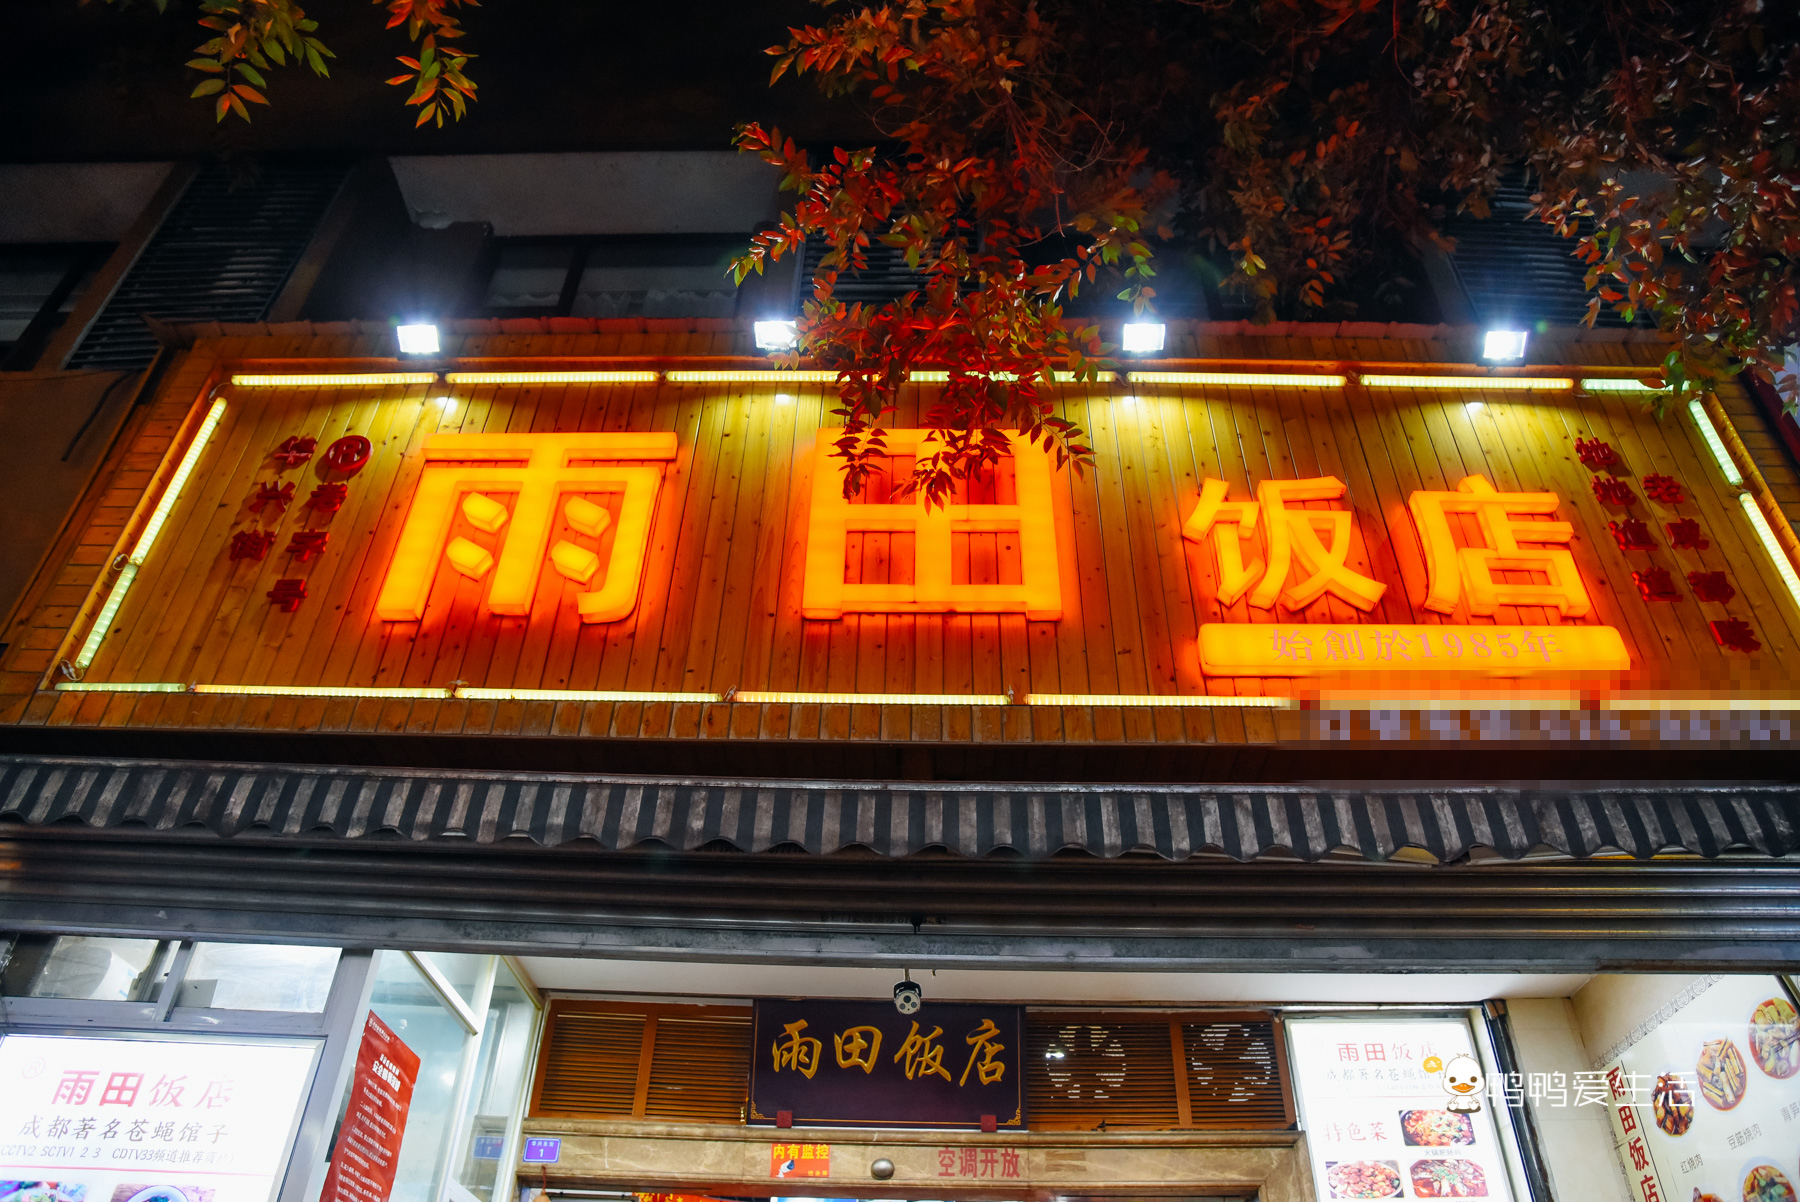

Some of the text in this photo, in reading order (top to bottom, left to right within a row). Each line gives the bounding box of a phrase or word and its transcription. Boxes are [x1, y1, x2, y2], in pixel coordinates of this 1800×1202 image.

[1270, 629, 1563, 663] 始創於1985年
[772, 1018, 1006, 1087] 雨田饭店
[1337, 1042, 1438, 1062] 雨田饭店
[51, 1069, 236, 1109] 雨田饭店
[18, 1115, 229, 1144] 成都著名苍蝇馆子
[1323, 1121, 1388, 1143] 特色菜
[1606, 1066, 1660, 1202] 雨田饭店
[539, 1148, 544, 1158] 1
[773, 1144, 829, 1159] 内有监控
[938, 1148, 1021, 1179] 空调开放
[1680, 1154, 1704, 1174] 红烧肉
